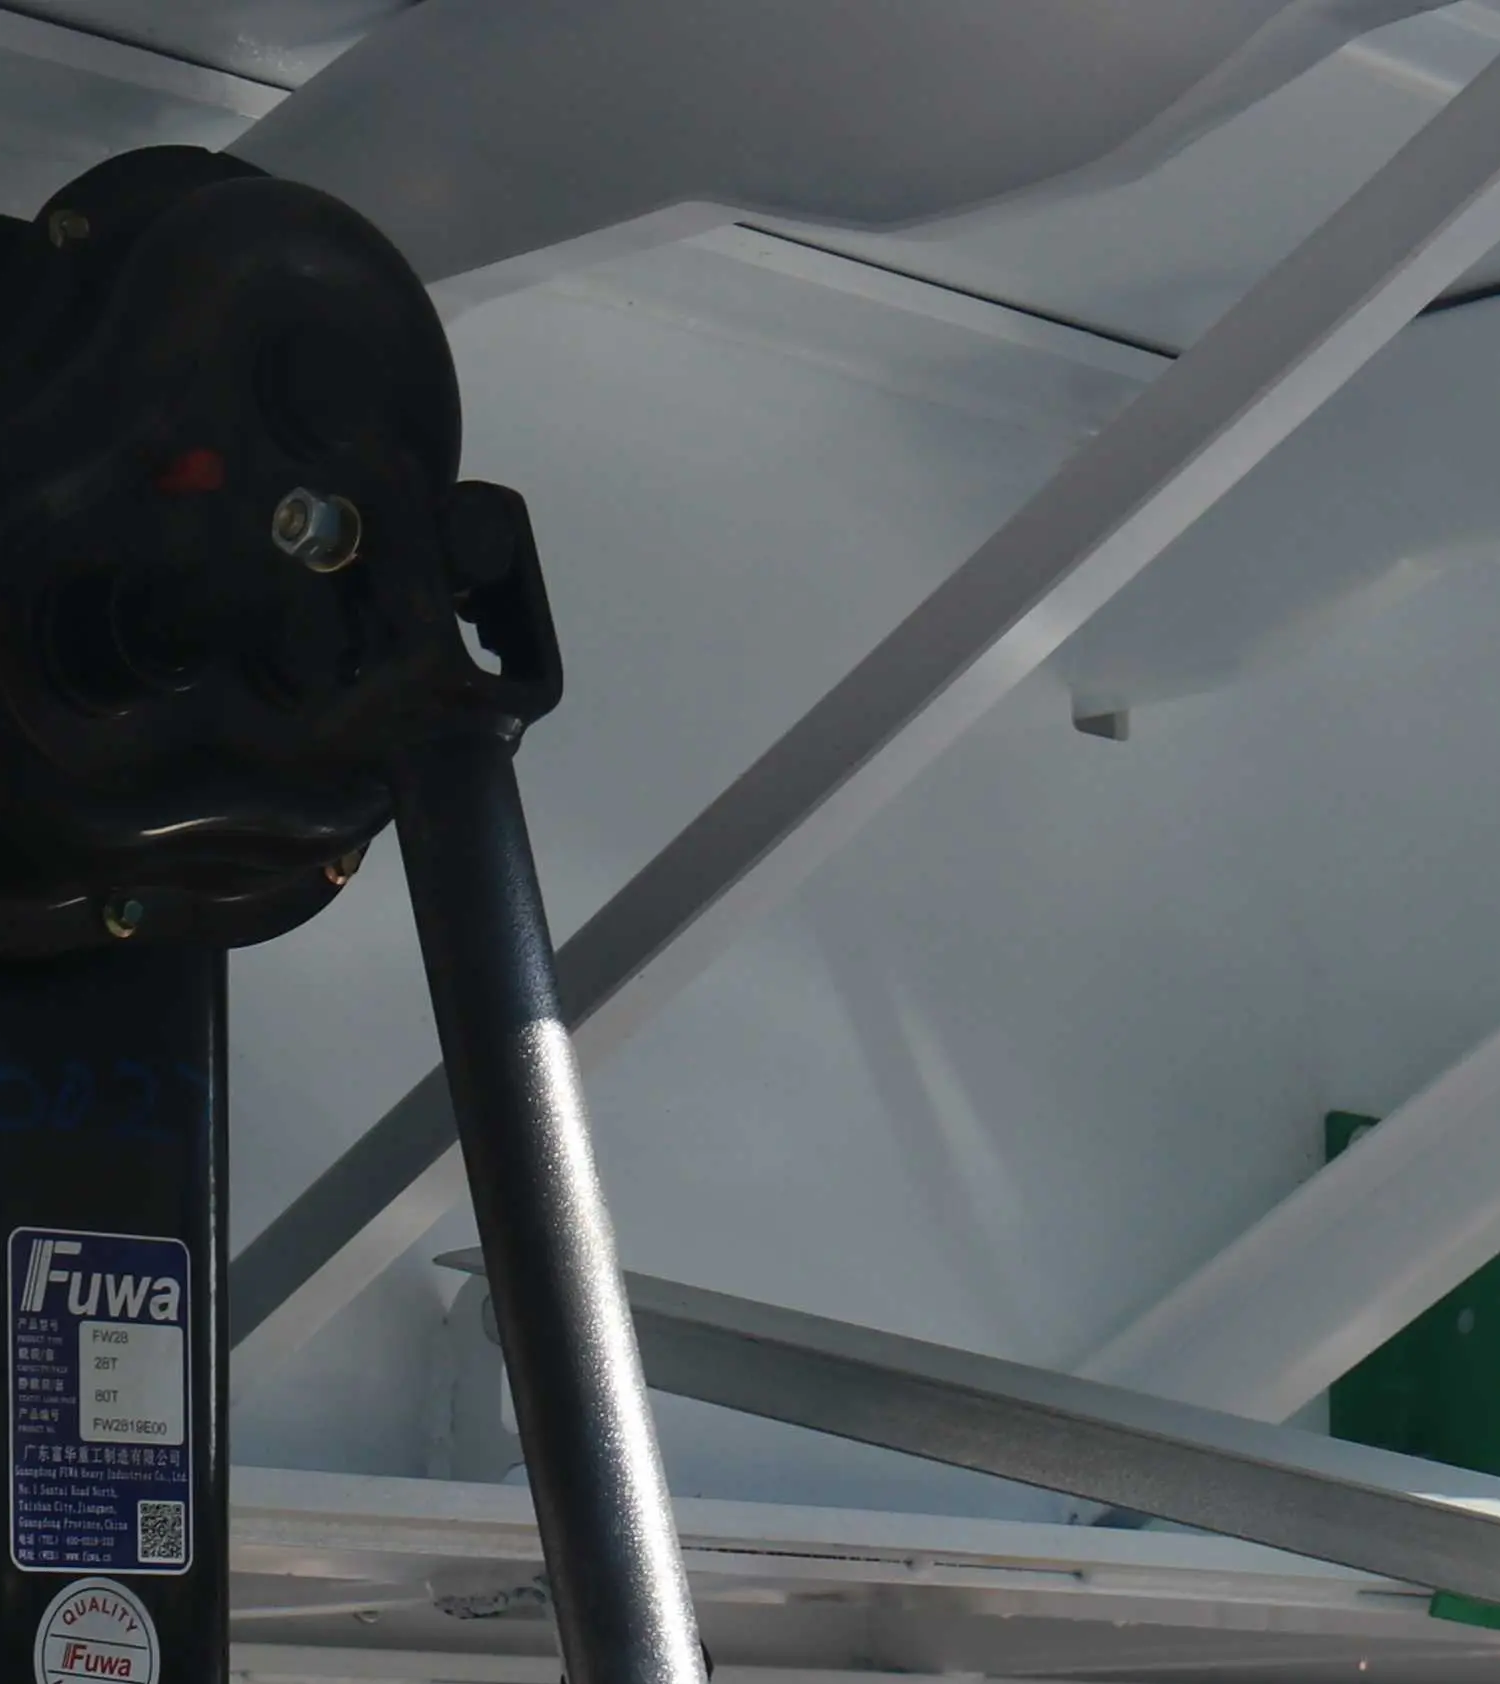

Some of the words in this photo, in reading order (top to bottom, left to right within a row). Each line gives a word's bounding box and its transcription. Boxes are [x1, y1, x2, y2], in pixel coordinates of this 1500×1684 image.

[20, 1238, 181, 1321] Fuwa
[92, 1329, 128, 1345] FW28
[94, 1357, 119, 1371] 28T
[62, 1597, 138, 1634] QUALITY
[62, 1643, 131, 1677] Fuwa
